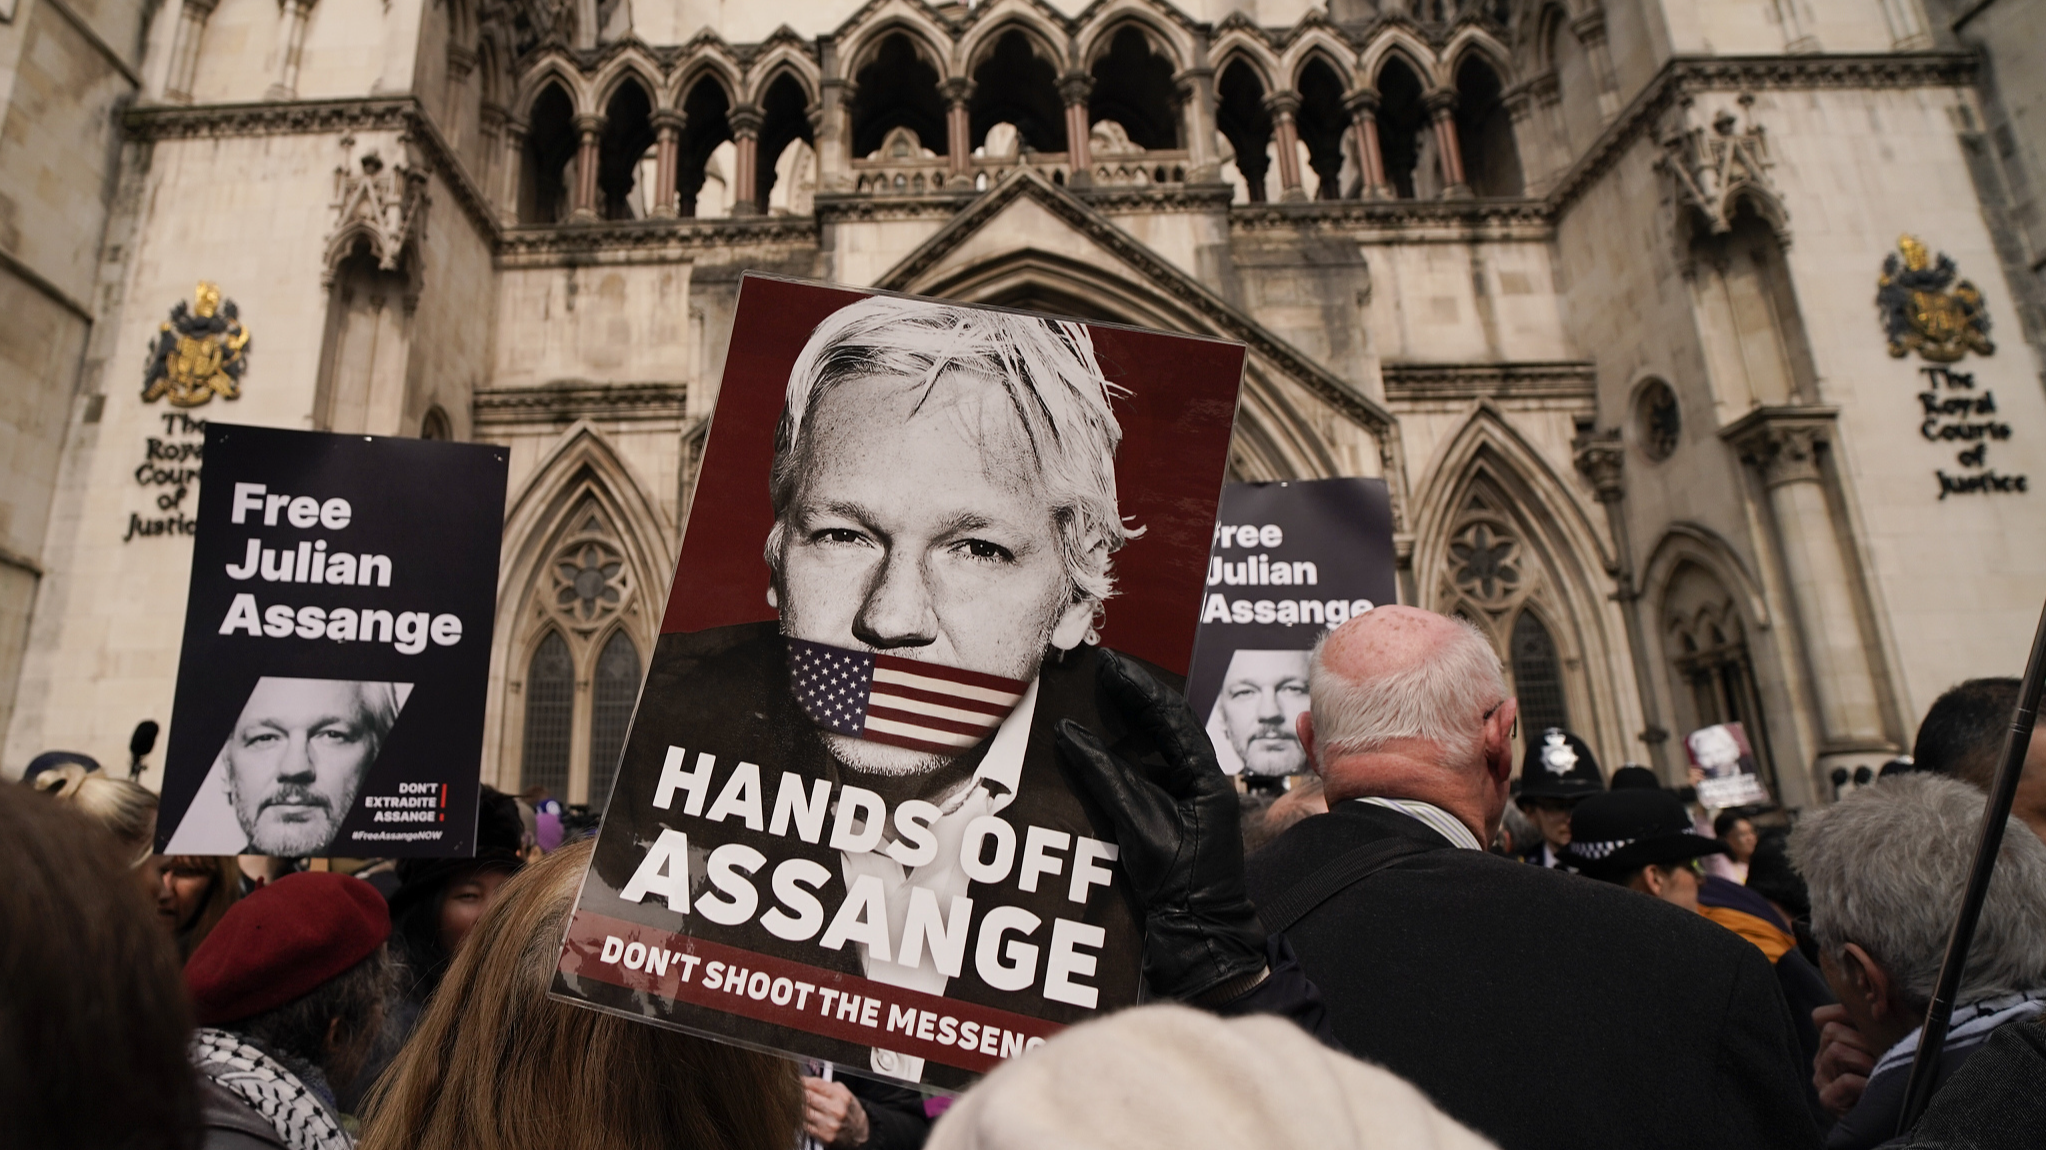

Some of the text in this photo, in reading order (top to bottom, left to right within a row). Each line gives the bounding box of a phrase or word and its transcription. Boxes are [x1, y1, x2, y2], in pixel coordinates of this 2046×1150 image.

[1919, 367, 1974, 389] The
[1918, 391, 1996, 419] Royal
[1920, 417, 2012, 441] Courts
[146, 438, 203, 462] Roya
[1957, 442, 1986, 467] of
[135, 462, 201, 486] Cour
[1935, 469, 2027, 500] Justice
[157, 486, 187, 510] of
[231, 482, 352, 530] Free
[123, 513, 196, 543] Justic
[225, 538, 392, 587] Julian
[1207, 553, 1318, 586] Julian
[218, 593, 462, 655] Assange
[399, 782, 438, 794] DON'T
[364, 796, 437, 808] EXTRADITE
[373, 811, 436, 822] ASSANGE
[652, 745, 1119, 904] HANDS OFF
[352, 830, 443, 842] #FreeAssangeNOW
[620, 829, 1105, 1009] ASSANGE
[600, 935, 701, 983] DON'T
[702, 961, 815, 1011] SHOOT
[819, 986, 881, 1029] THE
